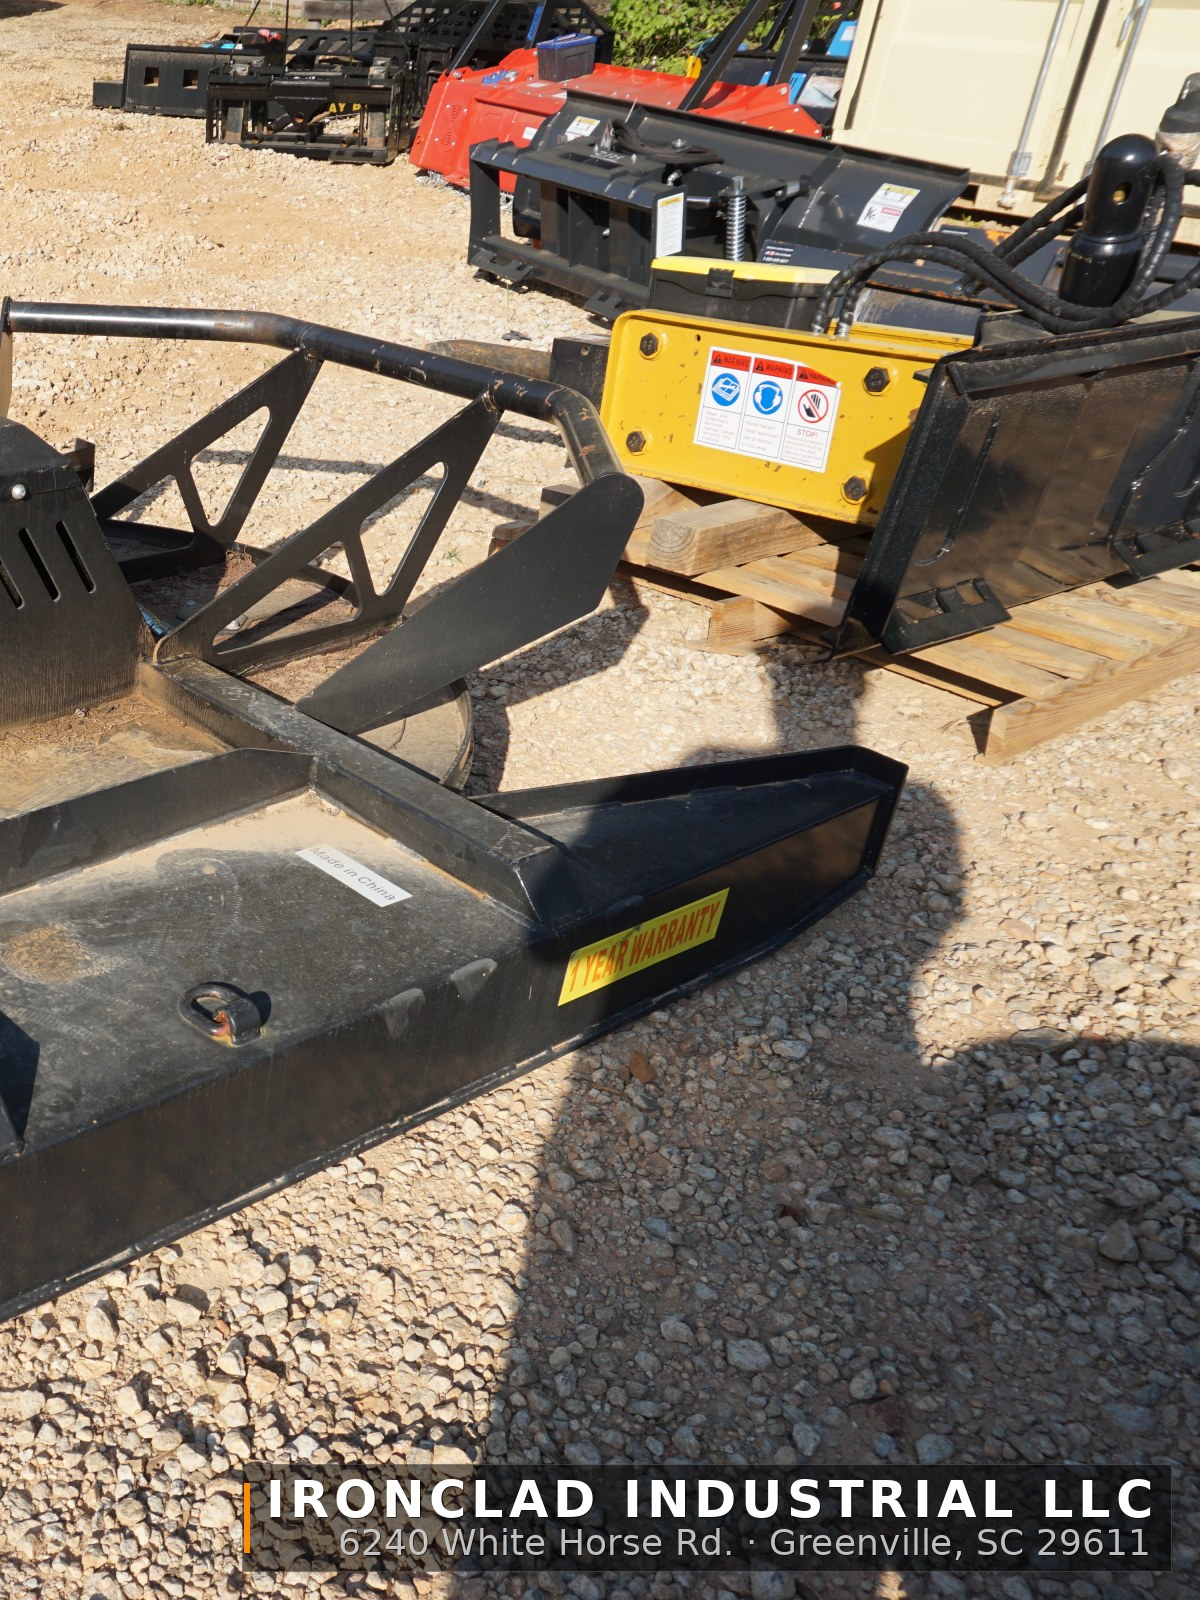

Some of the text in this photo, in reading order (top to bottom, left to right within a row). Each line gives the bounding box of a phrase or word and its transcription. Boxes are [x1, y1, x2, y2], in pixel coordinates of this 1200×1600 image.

[723, 356, 749, 368] WARNING
[765, 363, 792, 376] WARNING
[796, 428, 818, 439] STOP!
[310, 847, 397, 901] Made in China
[569, 901, 721, 993] 1 YEAR WARRANTY
